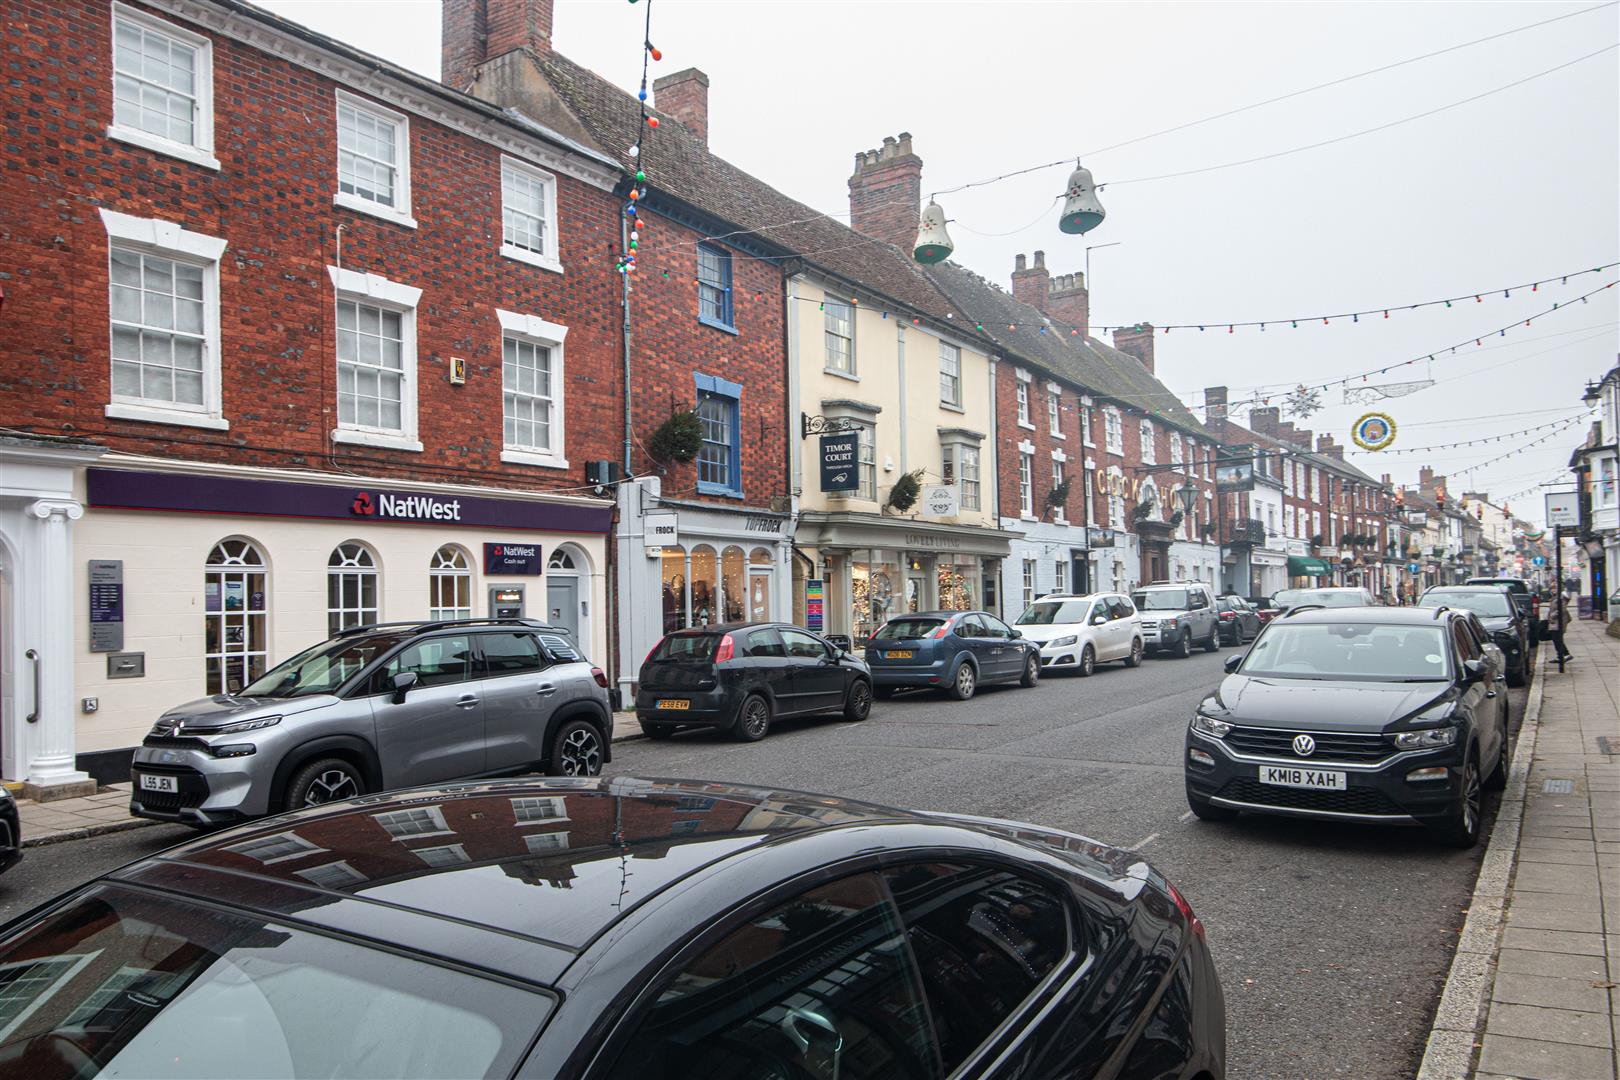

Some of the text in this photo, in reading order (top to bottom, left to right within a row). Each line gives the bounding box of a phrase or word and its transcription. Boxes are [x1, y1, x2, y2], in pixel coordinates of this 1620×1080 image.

[825, 443, 852, 453] TIMOR
[825, 453, 853, 462] COURT
[1097, 469, 1141, 504] COCK
[380, 494, 461, 520] NatWest
[745, 517, 783, 533] TOPFROCK
[905, 534, 934, 546] LOVELY
[503, 546, 535, 557] NatWest
[1268, 768, 1336, 787] KM18 XAH
[158, 778, 172, 790] JEN
